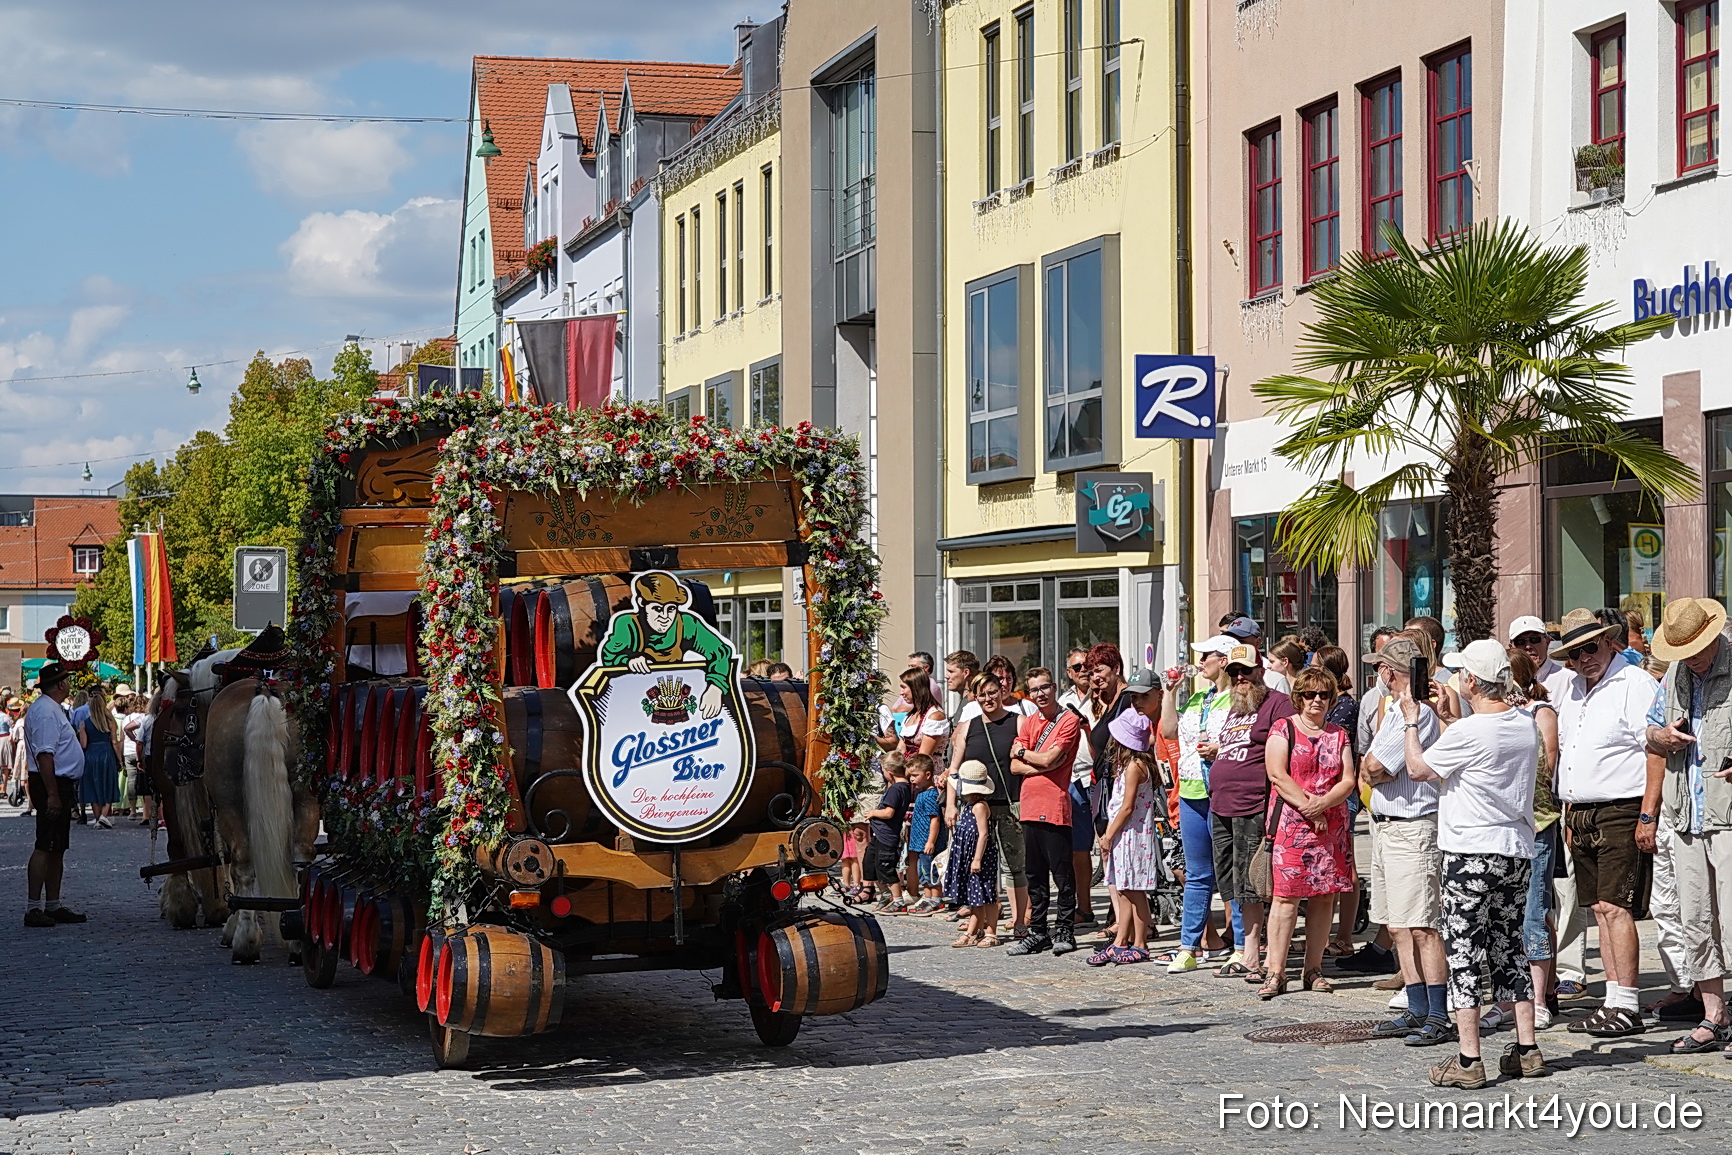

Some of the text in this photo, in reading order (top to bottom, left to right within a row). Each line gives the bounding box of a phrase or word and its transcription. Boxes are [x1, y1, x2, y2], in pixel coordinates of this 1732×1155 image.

[1142, 365, 1211, 427] R.
[1225, 457, 1268, 477] Unterer Markt 15
[1107, 494, 1133, 527] G2
[1415, 607, 1431, 617] MOND
[62, 649, 82, 659] SPUR
[611, 718, 724, 788] Glossner
[672, 754, 726, 782] Bier
[630, 785, 715, 805] Der hochfeine
[639, 803, 709, 822] Biergenuss
